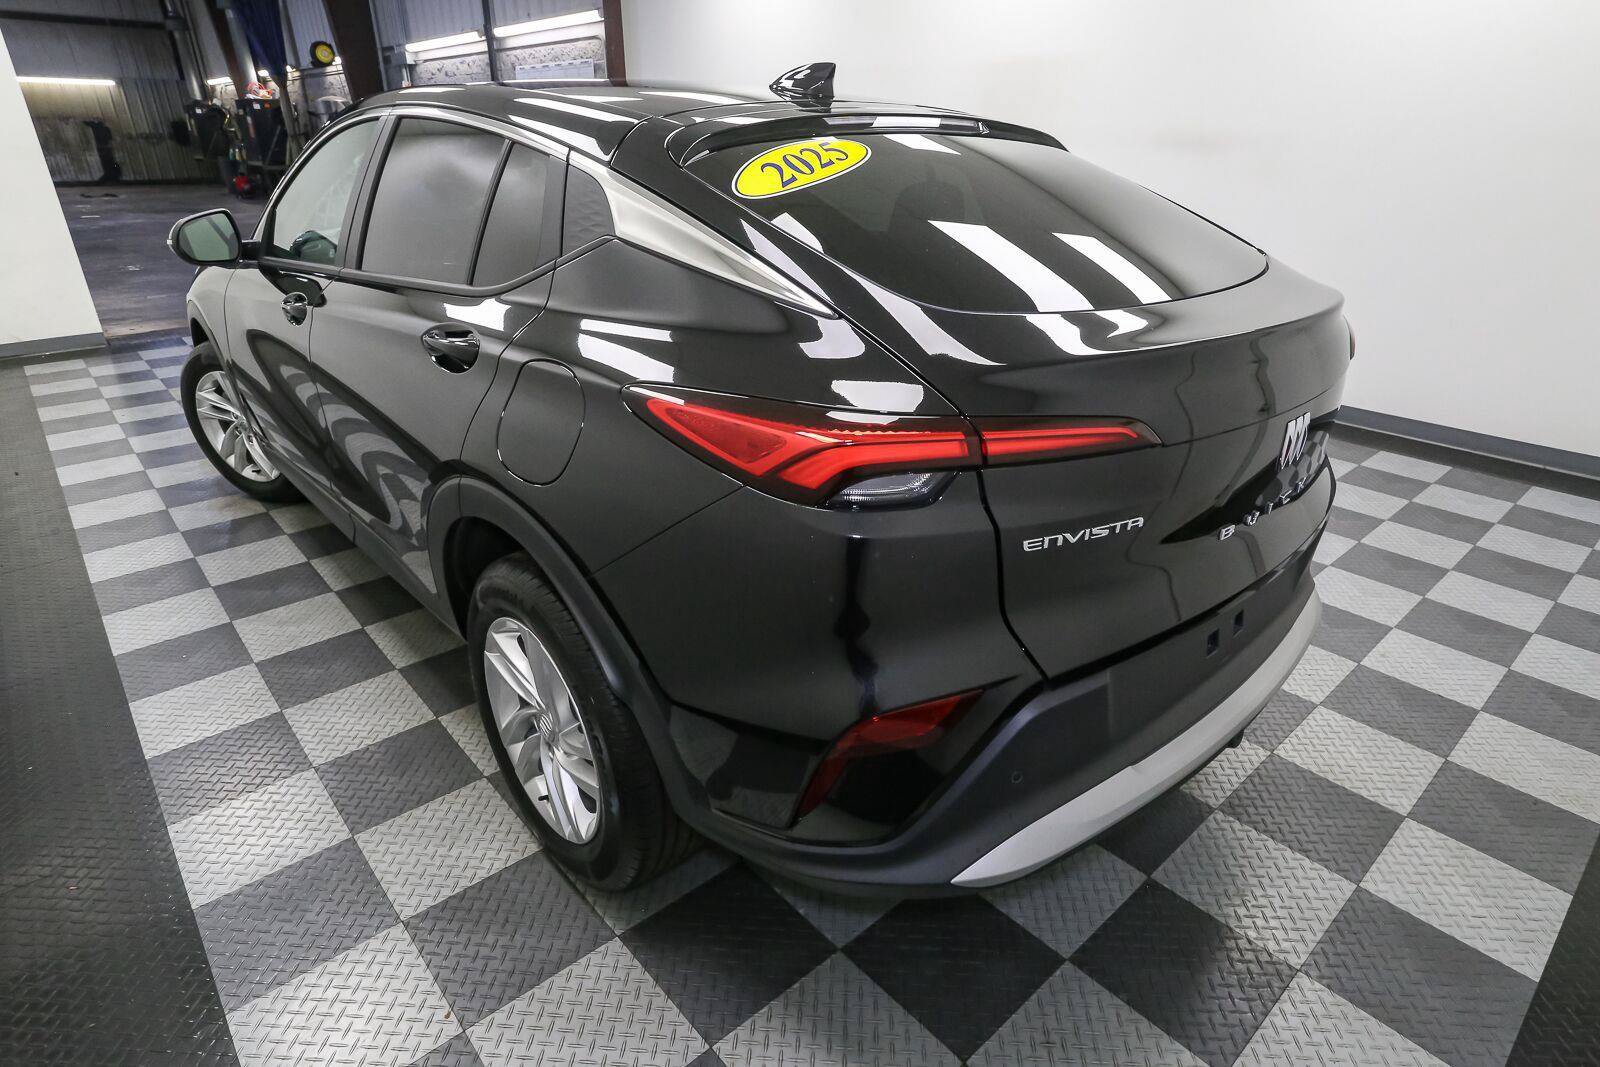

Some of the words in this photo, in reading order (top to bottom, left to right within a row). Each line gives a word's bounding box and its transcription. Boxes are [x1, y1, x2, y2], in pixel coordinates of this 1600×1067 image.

[761, 142, 849, 188] 2025
[1219, 477, 1307, 541] BUICK
[1023, 517, 1145, 552] ENVISTA
